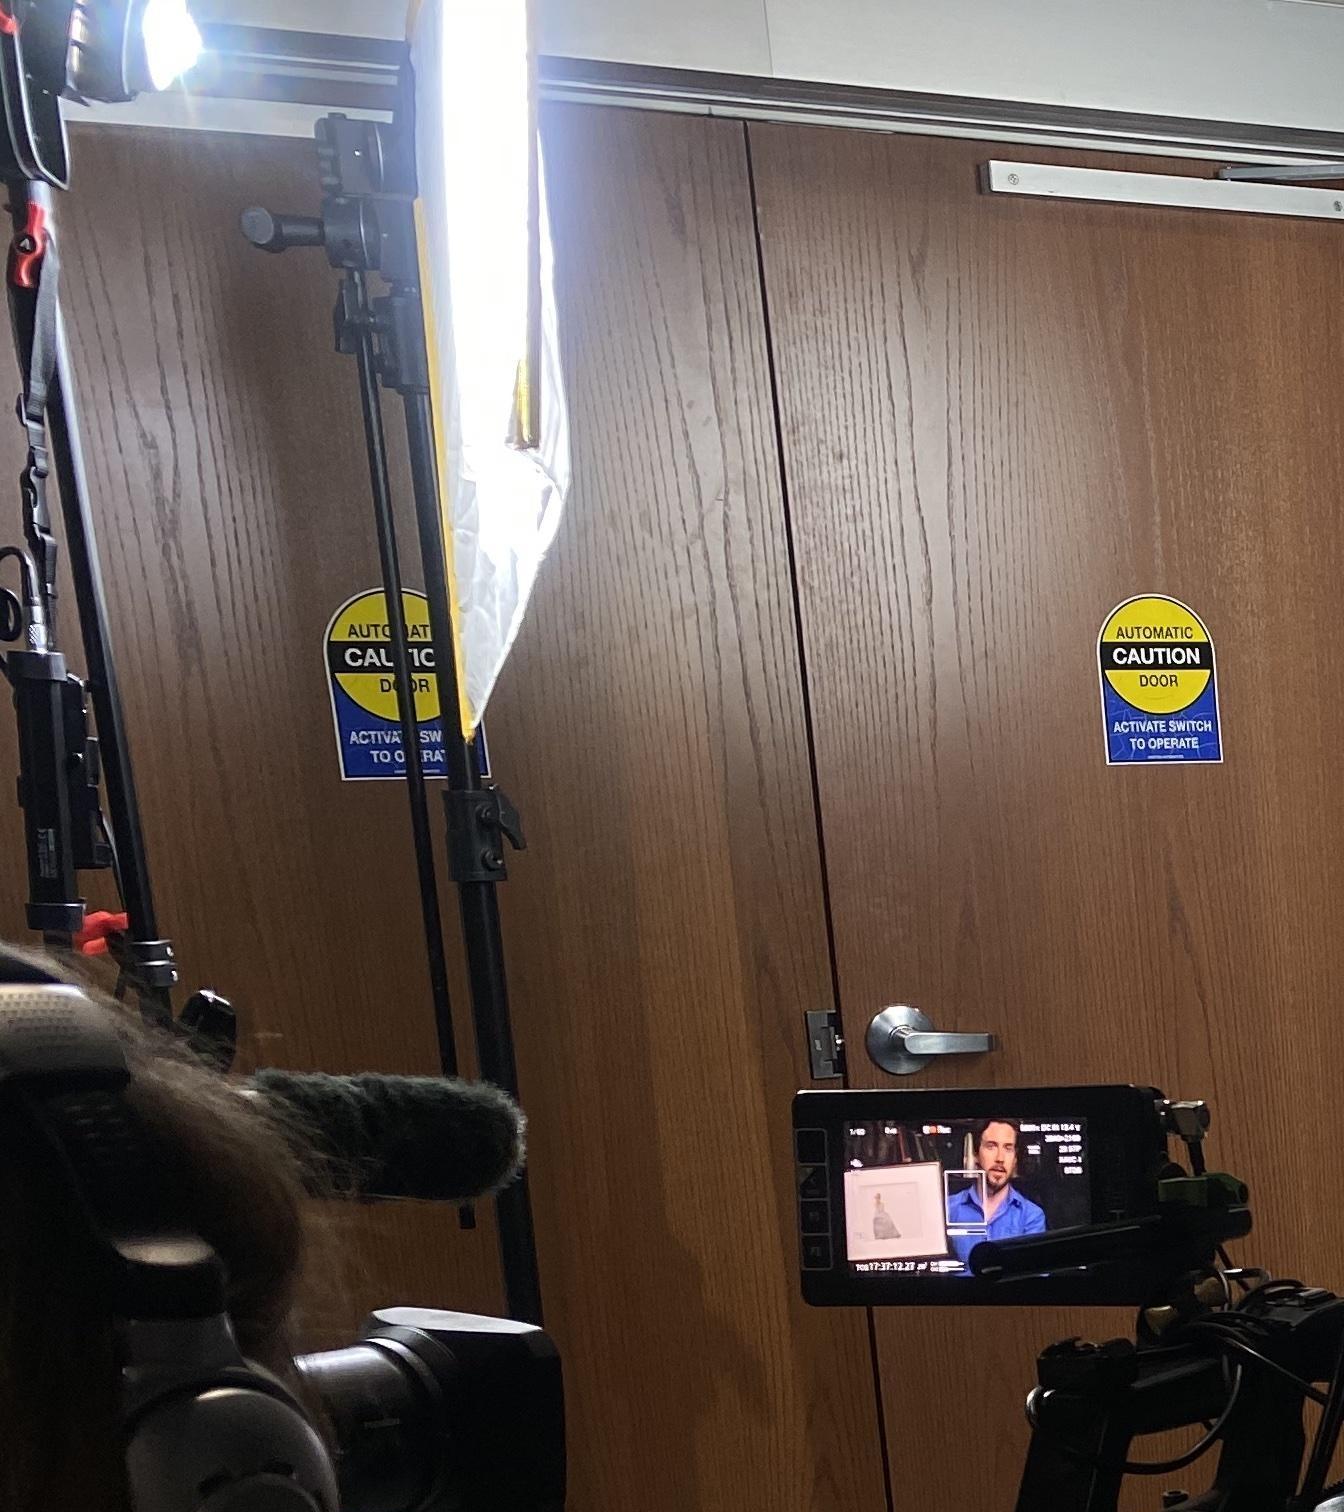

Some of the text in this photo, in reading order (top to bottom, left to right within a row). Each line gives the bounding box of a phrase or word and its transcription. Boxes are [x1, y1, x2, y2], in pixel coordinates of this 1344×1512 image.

[1116, 626, 1194, 640] AUTOMATIC
[1112, 647, 1201, 665] CAUTION
[1139, 674, 1179, 687] DOOR
[1113, 719, 1212, 733] ACTIVATE SWITCH
[1129, 737, 1199, 750] TO OPERATE
[370, 750, 391, 763] TO
